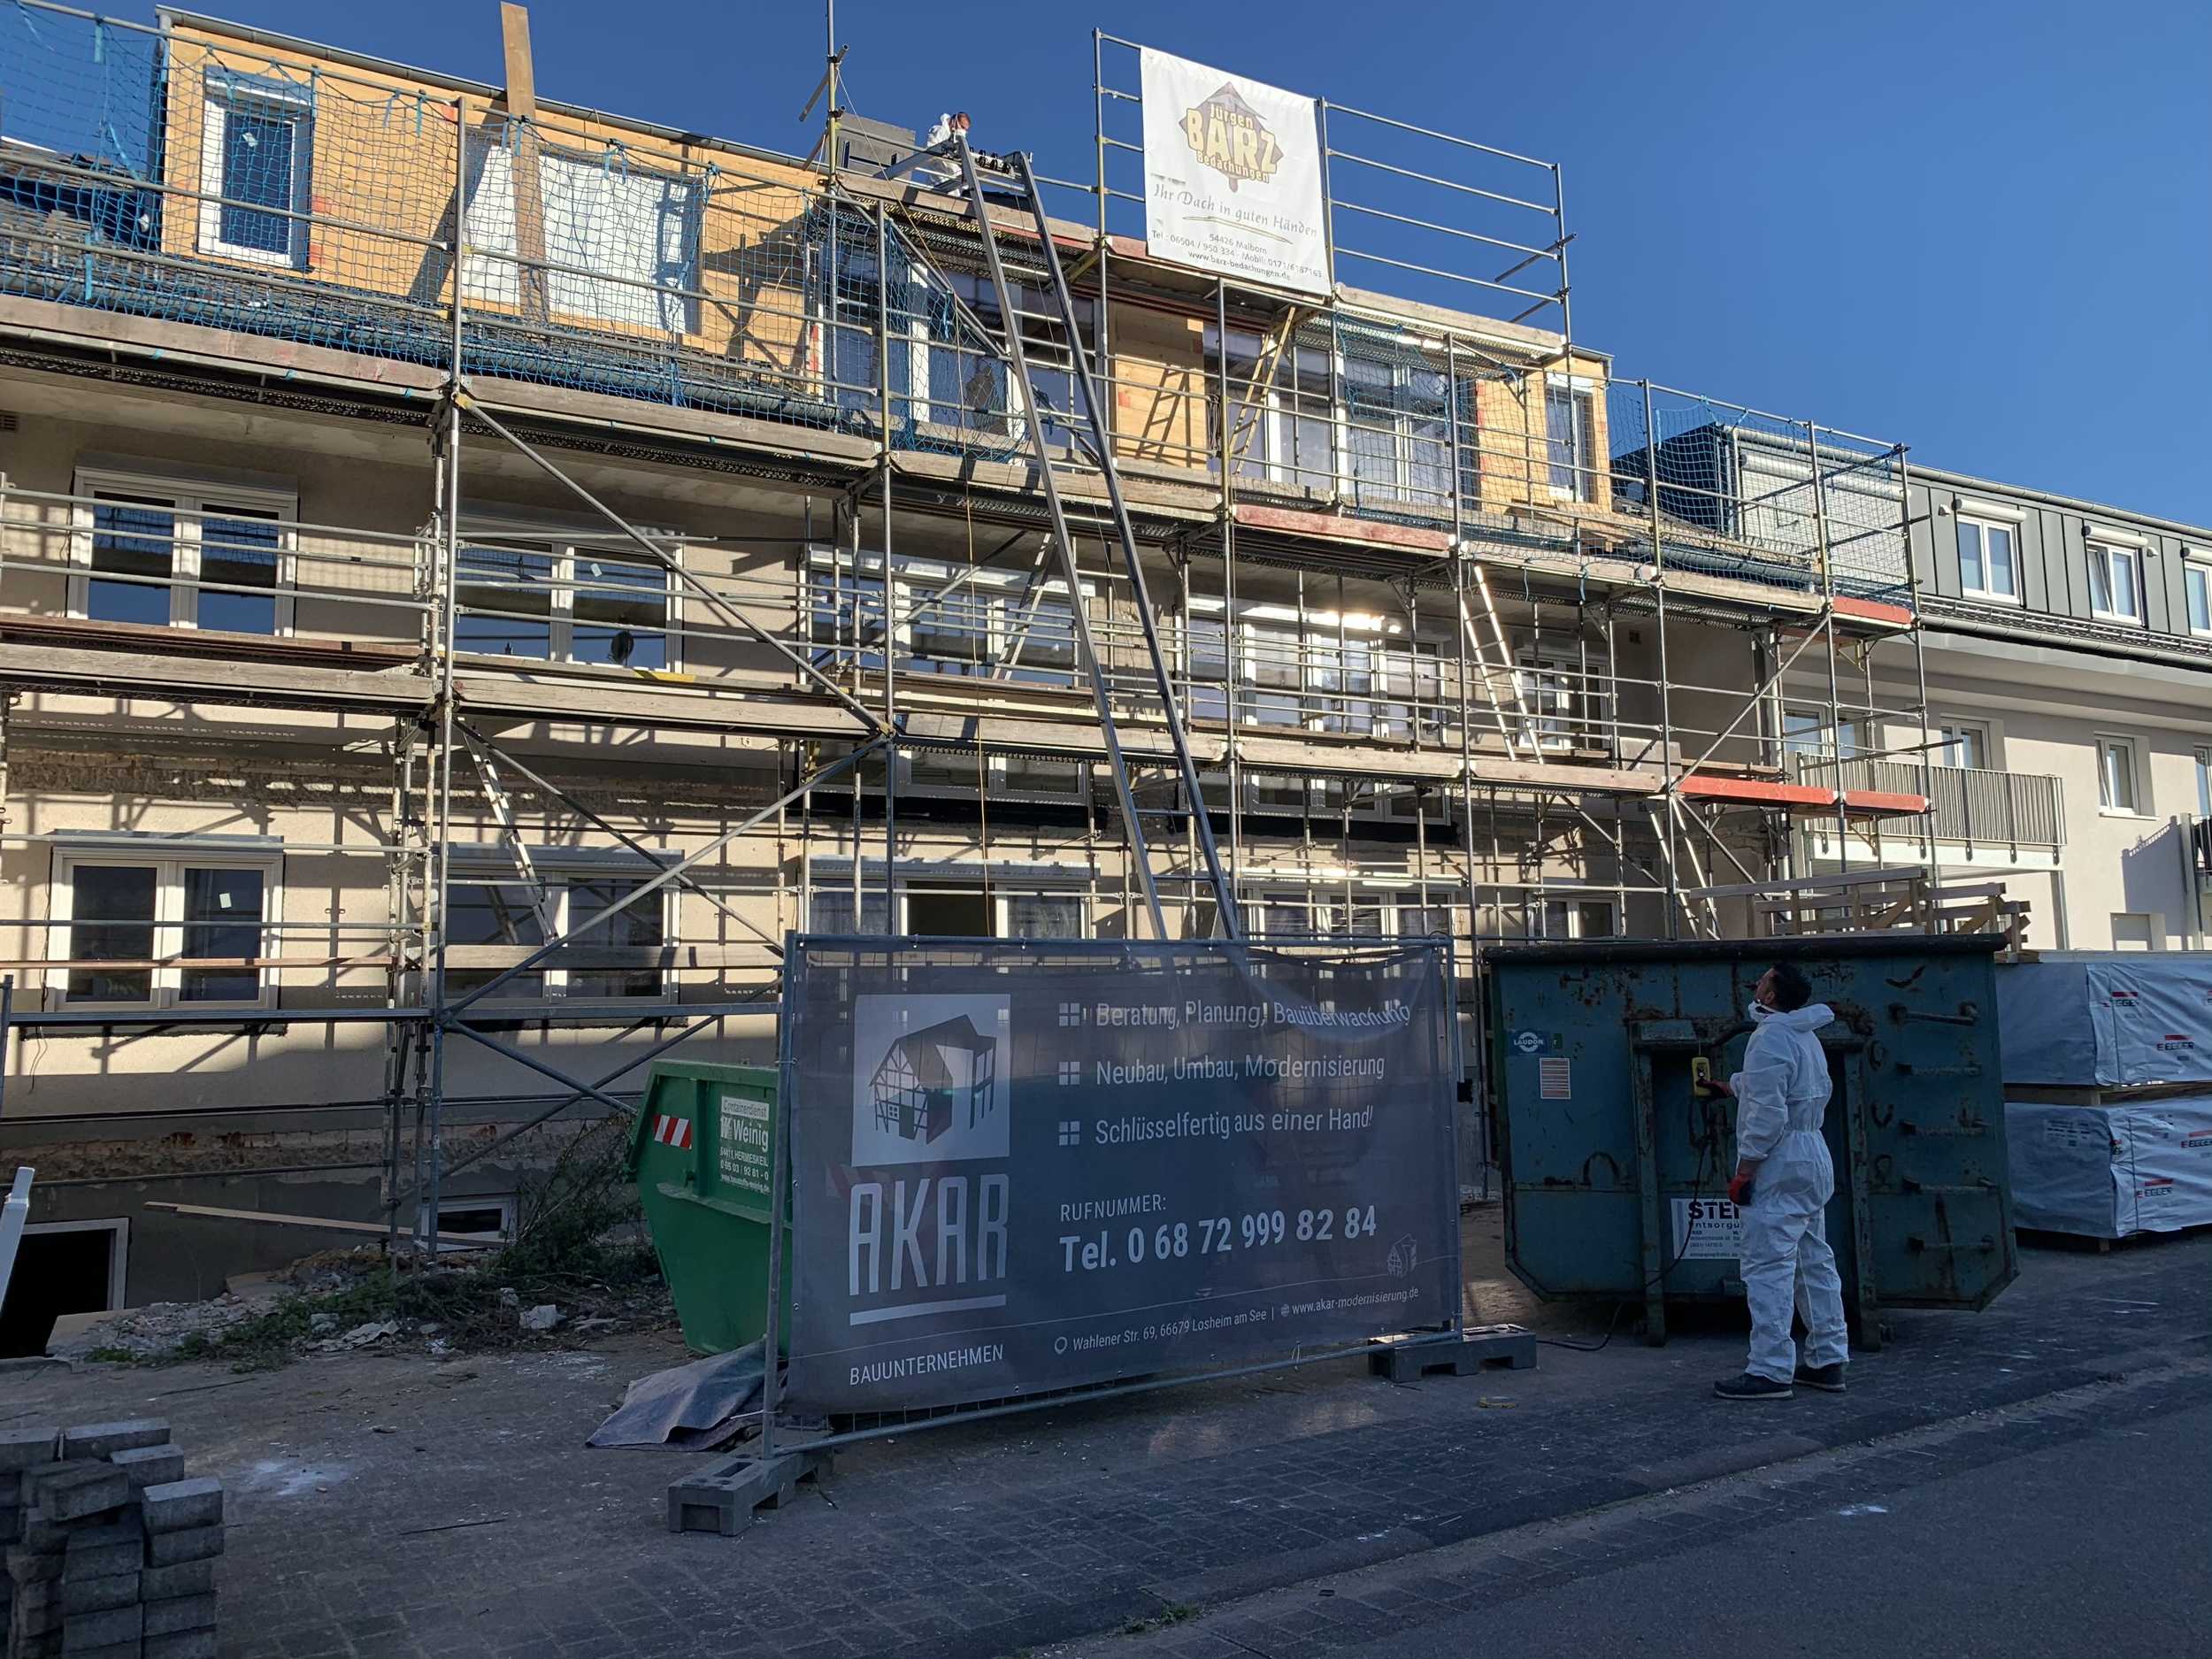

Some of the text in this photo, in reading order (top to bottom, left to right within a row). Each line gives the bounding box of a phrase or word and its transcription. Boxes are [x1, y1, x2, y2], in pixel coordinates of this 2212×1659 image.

[1210, 104, 1253, 129] Jürgen
[1187, 108, 1277, 173] BARZ
[1197, 150, 1269, 183] Bedachungen
[1155, 184, 1317, 237] Ihr Dach in guten Händen
[1152, 230, 1168, 241] Tel.:
[1170, 234, 1194, 248] 06504
[1203, 242, 1218, 253] 950
[1220, 246, 1234, 257] 334
[1242, 250, 1266, 265] Mobil:
[1268, 258, 1322, 278] 0171/6187163
[1209, 234, 1267, 255] 54426 Malborn
[1187, 251, 1291, 280] www.barz-bedachungen.de
[1097, 1000, 1410, 1030] Beratung, Planung, Bauüberwachung
[1097, 1055, 1385, 1085] Neubau, Umbau, Modernisierung
[724, 1100, 766, 1118] Containerdienst
[733, 1118, 769, 1153] Weinig
[1095, 1105, 1373, 1145] Schlüsselfertig aus einer Hand!
[733, 1164, 740, 1173] 03
[743, 1166, 751, 1176] 92
[764, 1171, 769, 1180] 0
[734, 1150, 768, 1167] HERMESKEIL
[2145, 1187, 2172, 1196] EGGER
[1061, 1194, 1166, 1222] RUFNUMMER:
[1688, 1202, 1739, 1219] STEI
[849, 1173, 1010, 1296] AKAR
[1059, 1205, 1377, 1272] Tel. 0 68 72 999 82 84
[1072, 1334, 1122, 1351] Wahlener
[1124, 1330, 1140, 1343] Str.
[1143, 1326, 1157, 1340] 69,
[1160, 1320, 1189, 1337] 66679
[1192, 1315, 1232, 1332] Losheim
[1234, 1313, 1248, 1325] am
[1249, 1310, 1267, 1322] See
[1292, 1286, 1419, 1315] www.akar-modernisierung.de
[849, 1344, 1003, 1386] BAUUNTERNEHMEN
